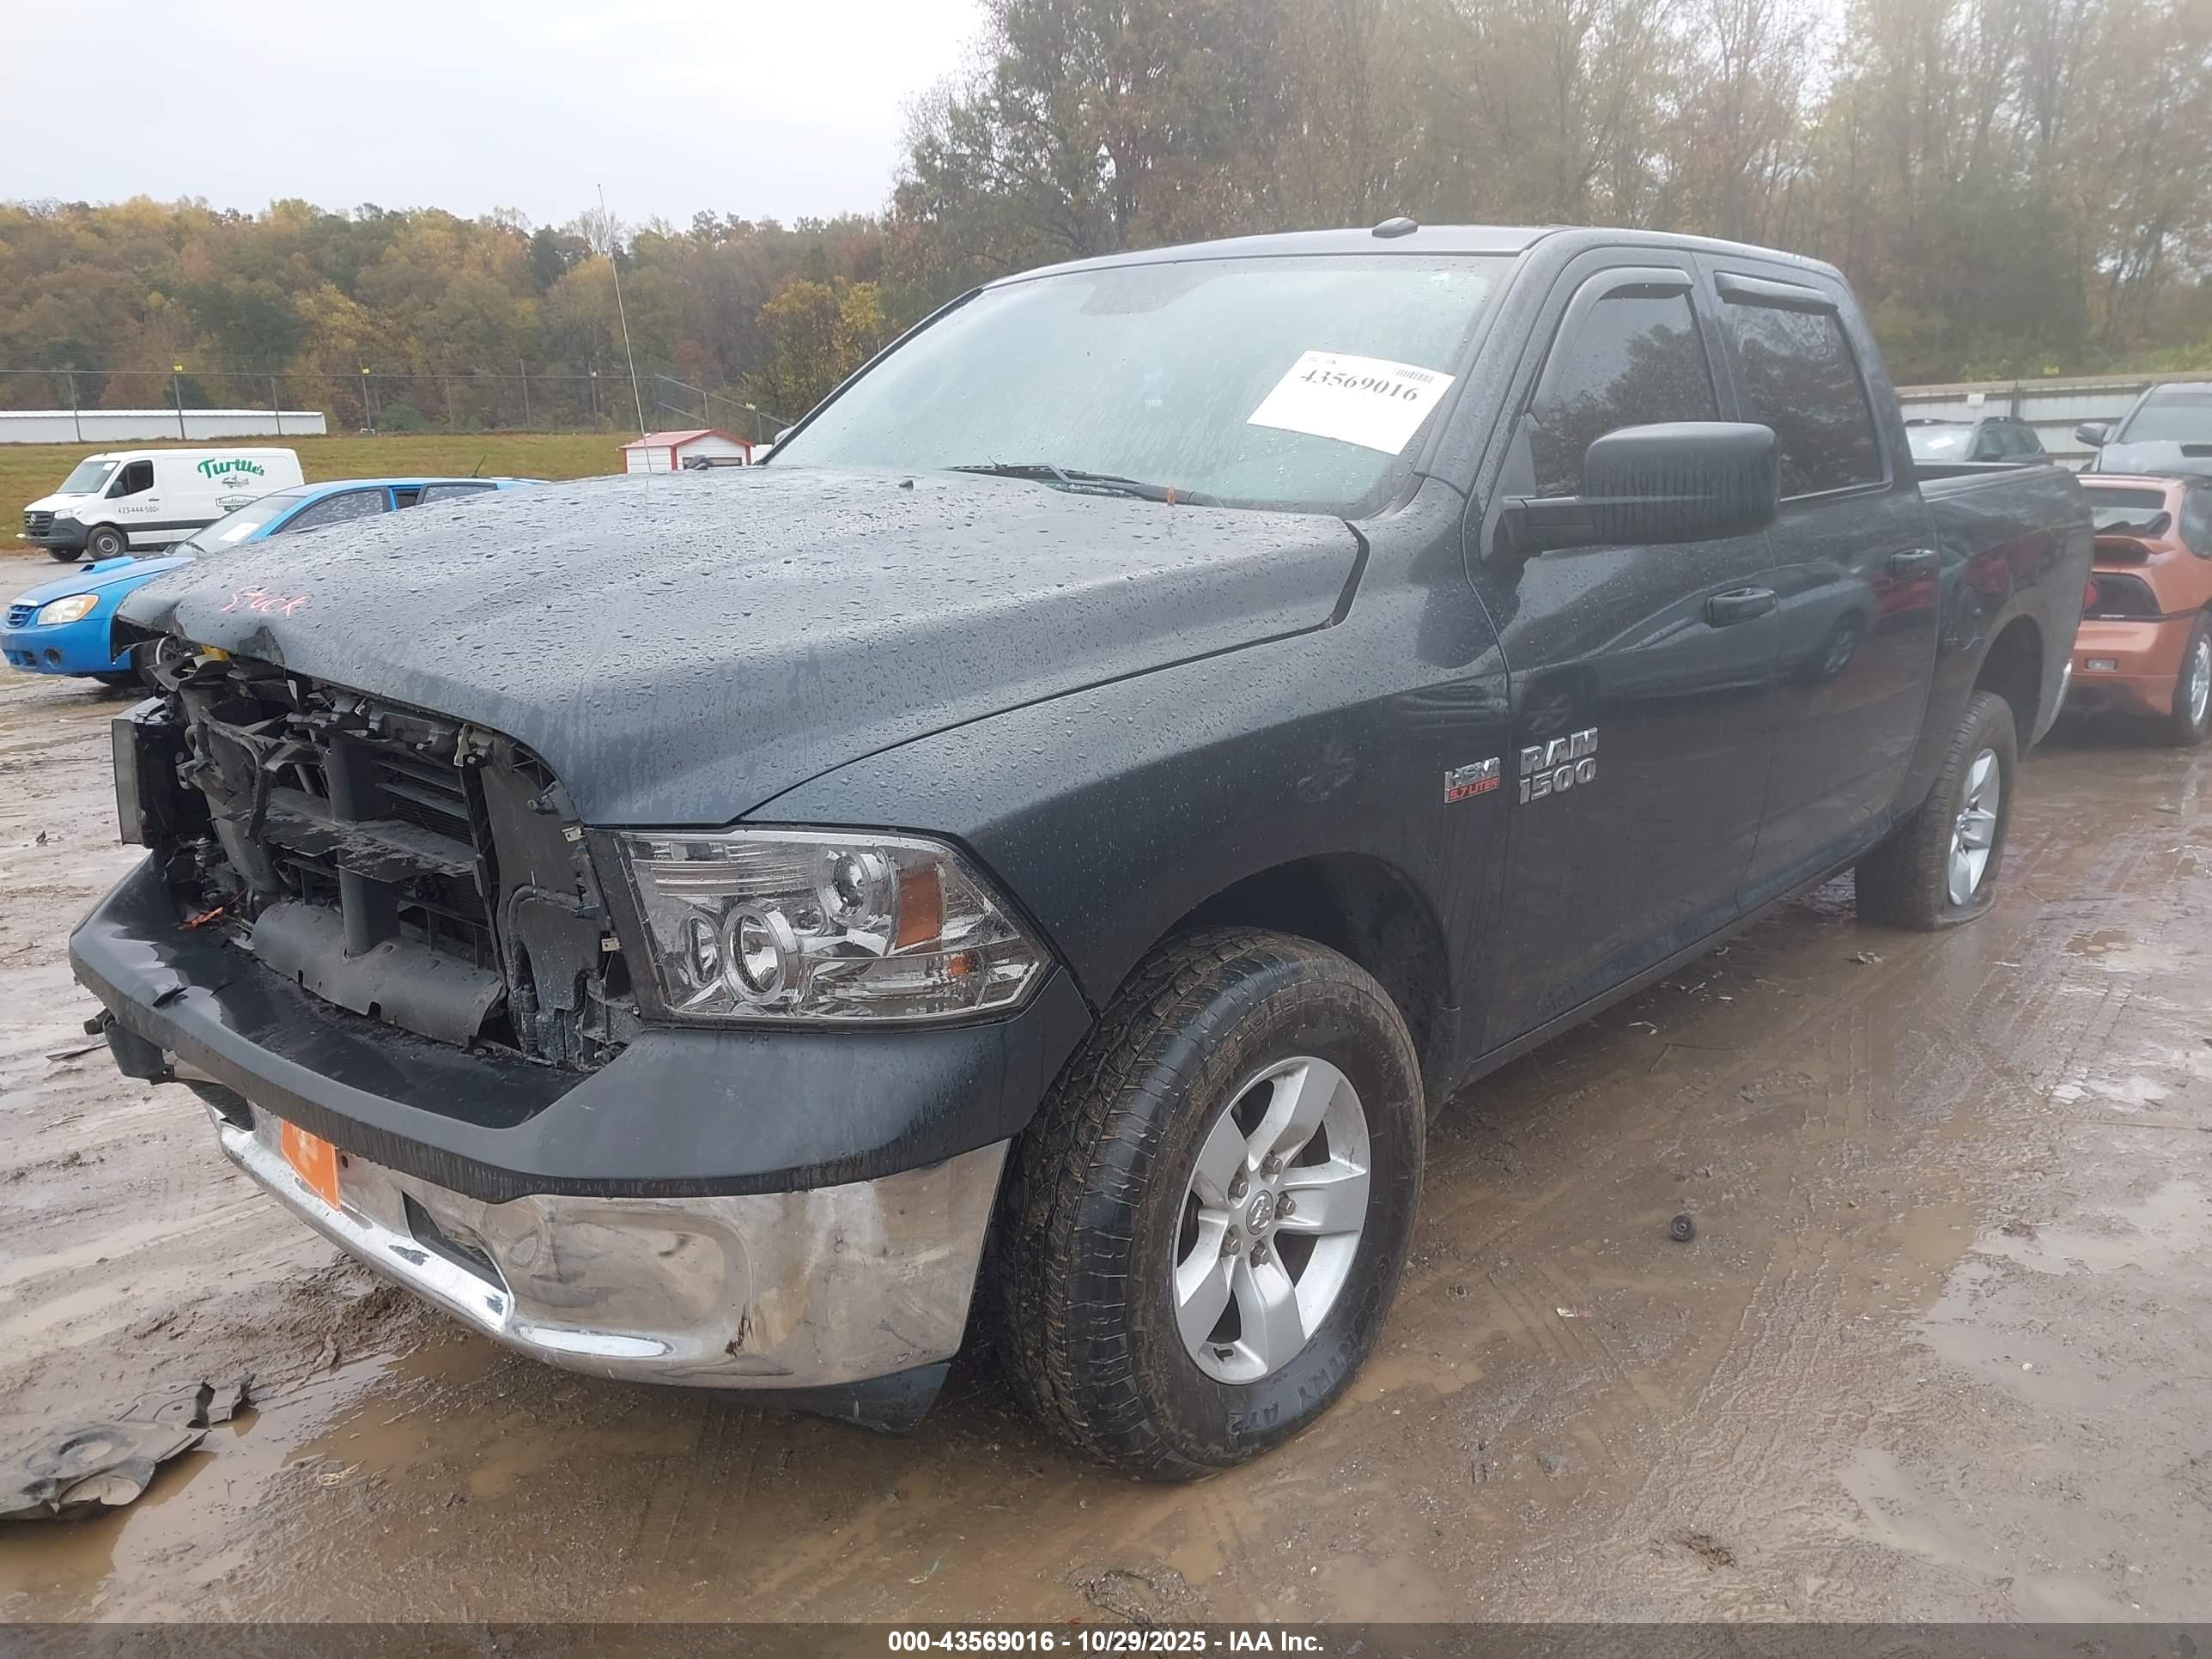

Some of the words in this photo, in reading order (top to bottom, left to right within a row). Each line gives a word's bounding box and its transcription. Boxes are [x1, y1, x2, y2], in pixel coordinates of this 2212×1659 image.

[1300, 369, 1419, 401] 43569016
[1519, 727, 1598, 776] RAM
[1449, 785, 1468, 800] 5.7
[1469, 775, 1498, 795] LITER
[1519, 757, 1596, 805] 1500
